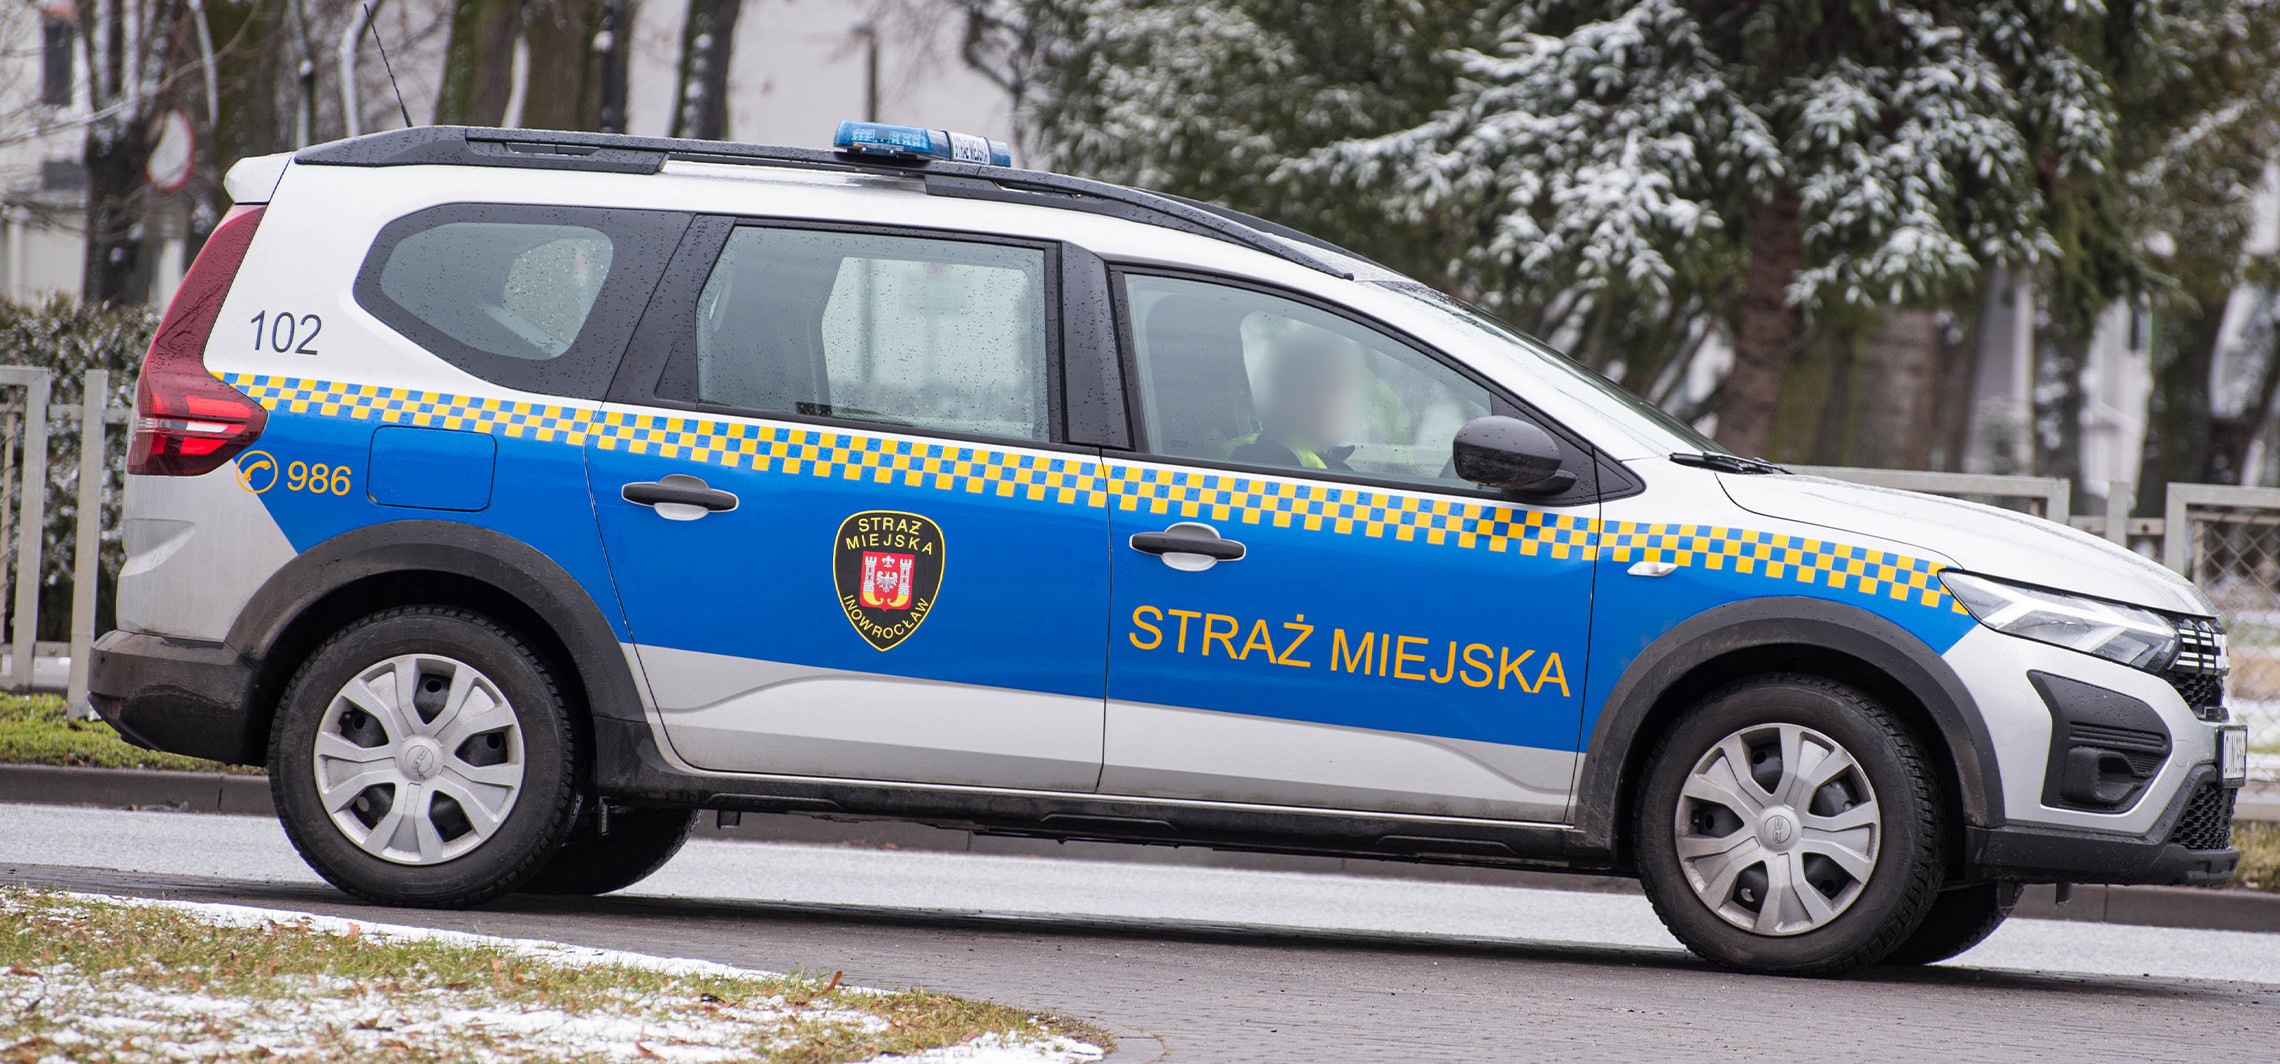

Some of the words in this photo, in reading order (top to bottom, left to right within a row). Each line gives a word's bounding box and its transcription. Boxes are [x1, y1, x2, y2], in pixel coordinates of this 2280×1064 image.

[252, 311, 321, 355] 102
[287, 461, 351, 495] 986
[846, 533, 932, 555] MIEJSKA
[844, 594, 929, 638] INOWROCŁAW
[1129, 606, 1314, 667] STRAŻ
[1331, 629, 1571, 696] MIEJSKA
